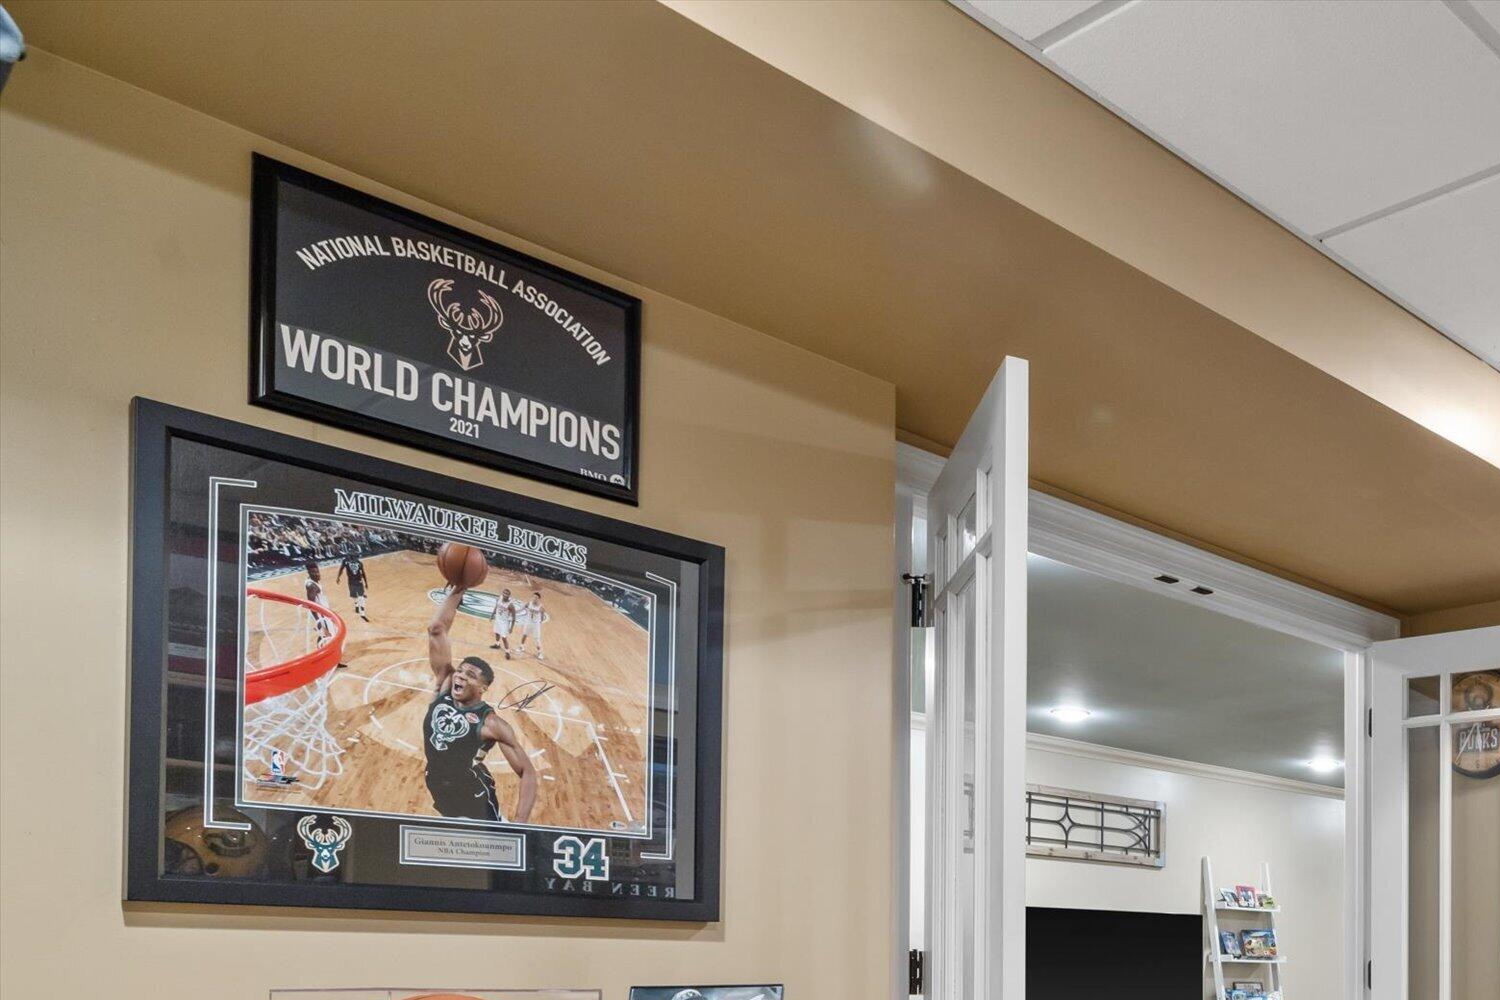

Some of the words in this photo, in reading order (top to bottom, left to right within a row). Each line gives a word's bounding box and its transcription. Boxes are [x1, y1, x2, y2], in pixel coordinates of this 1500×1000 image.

[296, 234, 391, 271] NATIONAL
[390, 236, 509, 288] BASKETBALL
[511, 279, 612, 368] ASSOCIATION
[280, 323, 420, 402] WORLD
[430, 371, 621, 461] CHAMPIONS
[449, 416, 480, 440] 2021
[334, 488, 499, 541] MILWAUKEE
[507, 524, 588, 567] BUCKS
[413, 837, 447, 848] Giannis
[553, 835, 610, 881] 34
